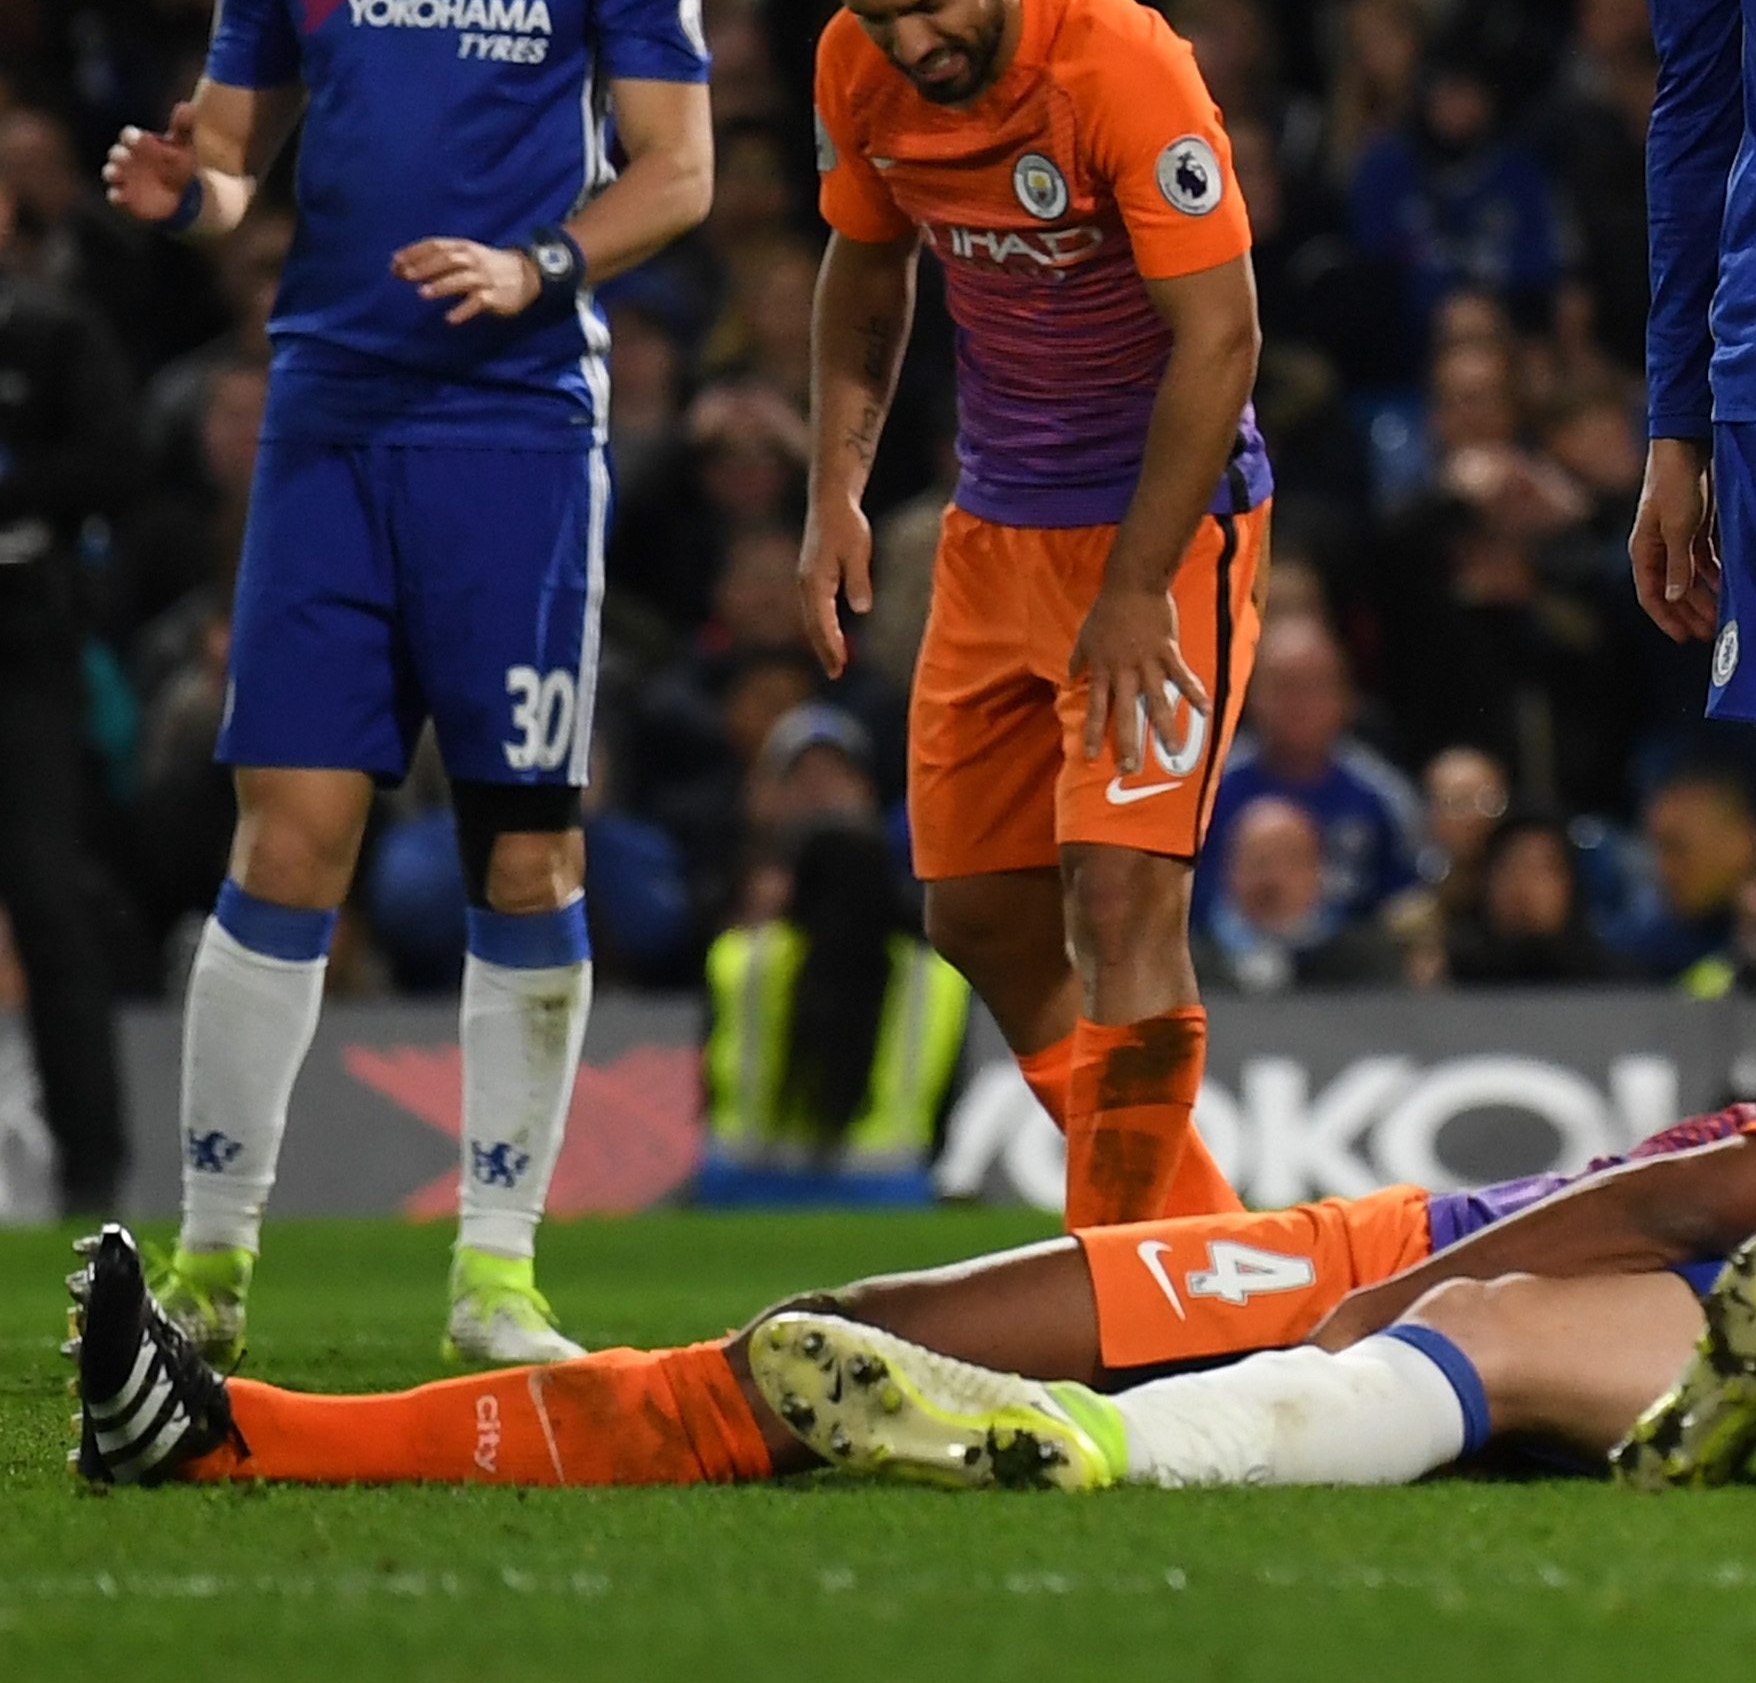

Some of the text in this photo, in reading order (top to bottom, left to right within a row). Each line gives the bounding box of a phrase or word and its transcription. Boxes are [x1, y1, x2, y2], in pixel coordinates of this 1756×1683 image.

[456, 33, 550, 65] TYRES
[919, 220, 1103, 265] IHAD
[502, 665, 575, 772] 30
[1185, 1239, 1316, 1307] 4
[473, 1393, 502, 1474] City
